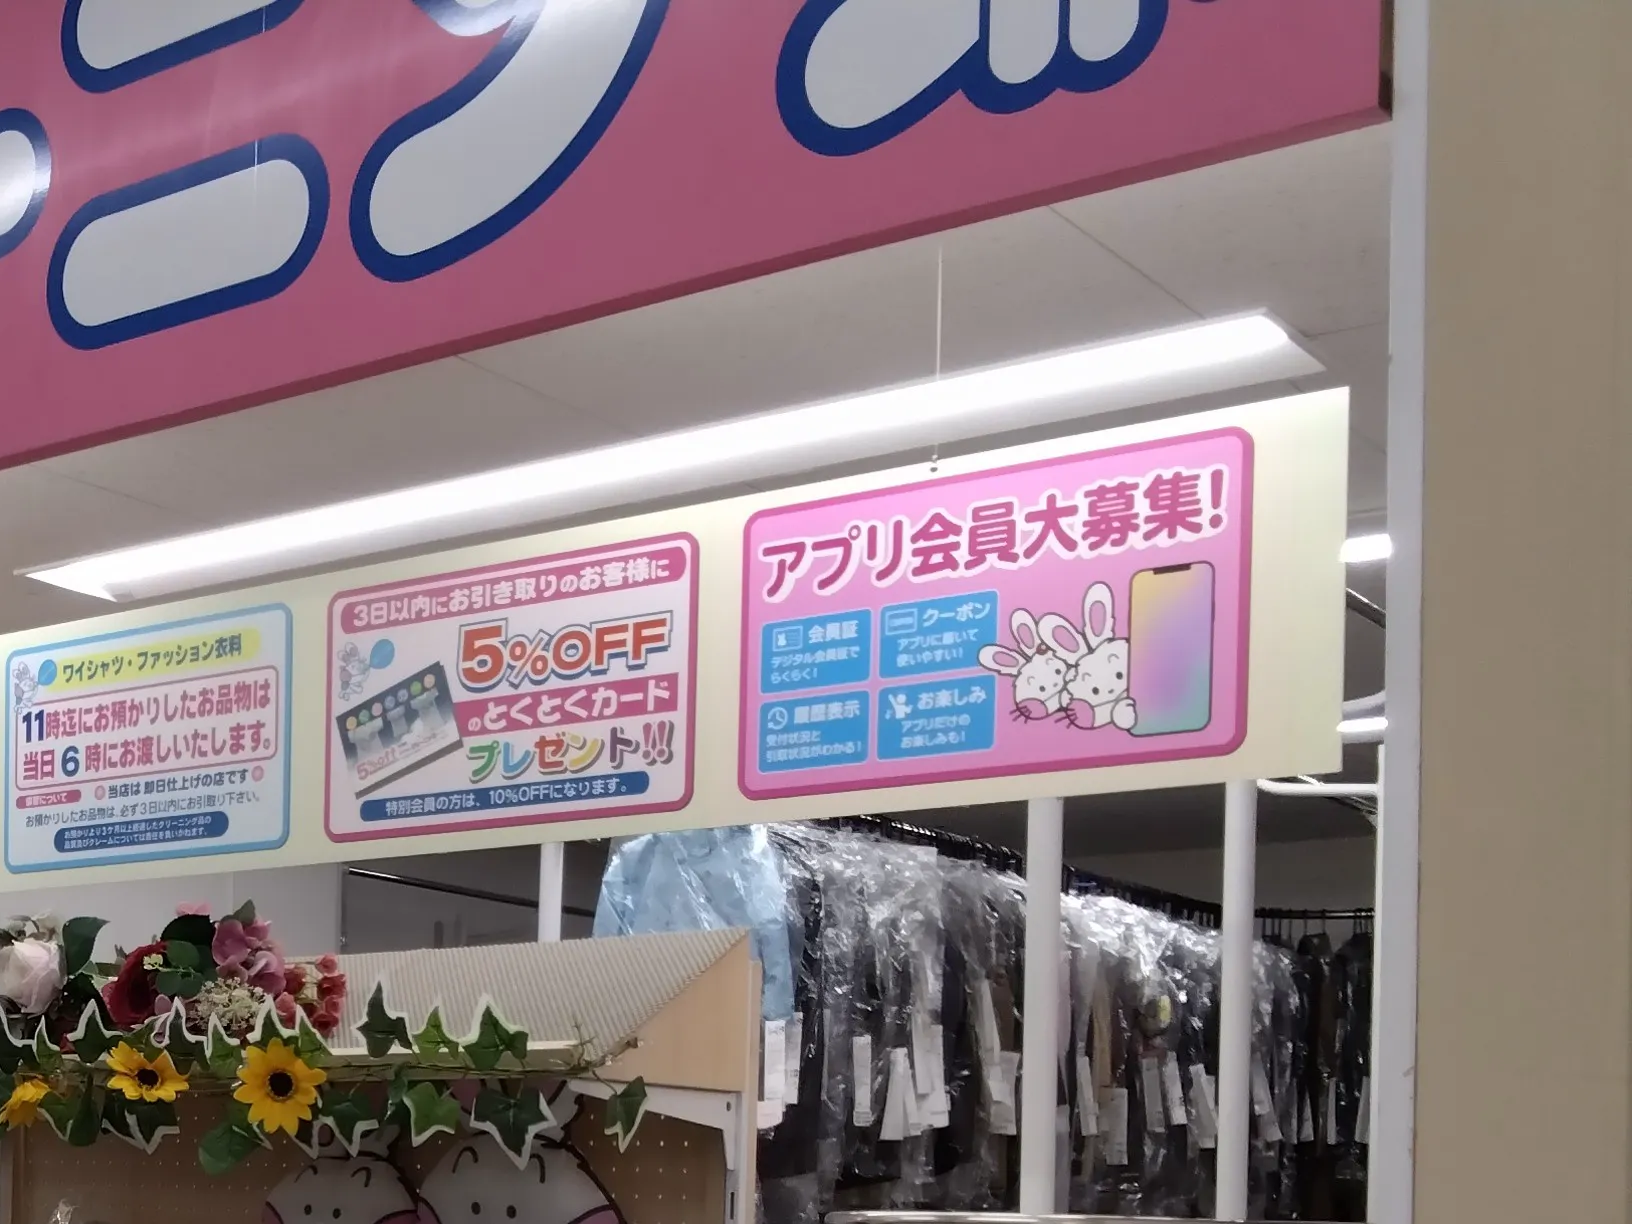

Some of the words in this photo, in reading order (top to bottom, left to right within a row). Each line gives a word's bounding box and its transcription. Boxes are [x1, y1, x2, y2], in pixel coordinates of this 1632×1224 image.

[761, 465, 1227, 601] アプリ会員大募集!
[353, 558, 670, 628] 3日以内にお引き取りのお客様に
[923, 602, 991, 627] クーポン
[459, 612, 672, 691] 5%OFF
[808, 620, 859, 643] 会員証
[63, 634, 242, 683] ワイシャツ・ファッション衣料
[22, 679, 271, 743] 11時迄にお預かりしたお品物は
[468, 680, 671, 732] のとくとくカード
[917, 685, 987, 711] お楽しみ
[900, 714, 972, 733] アプリだけの
[468, 720, 674, 782] プレゼント!!
[385, 778, 628, 817] 特別会員の方は、10%OFFになります。
